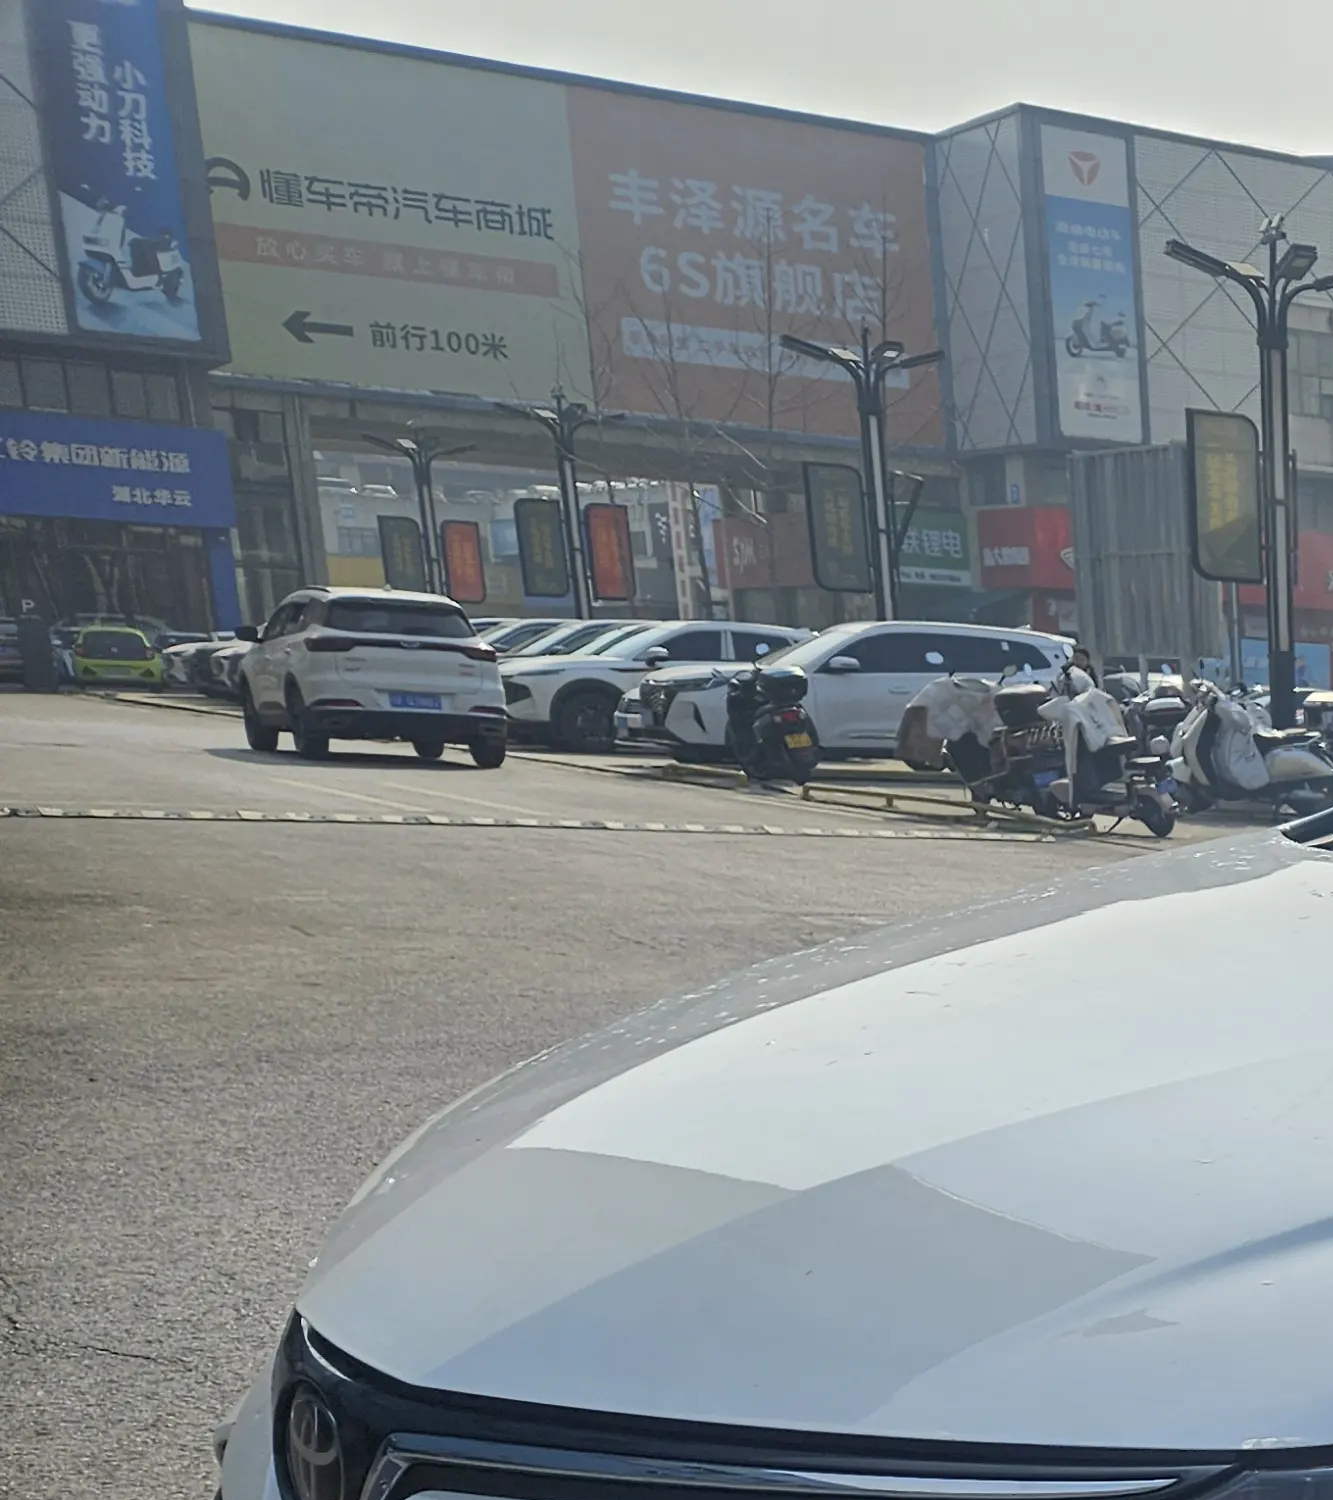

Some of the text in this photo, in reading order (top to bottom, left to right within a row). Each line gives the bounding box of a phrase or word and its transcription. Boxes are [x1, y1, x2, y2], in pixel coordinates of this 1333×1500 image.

[67, 20, 111, 143] 更强动力
[113, 60, 157, 180] 小刀科技
[258, 168, 555, 241] 懂车帝汽车商城
[607, 166, 900, 259] 丰泽源名车
[255, 235, 365, 268] 放心买车
[640, 245, 884, 328] 6S旗舰店
[369, 320, 509, 360] 前行100米
[0, 436, 191, 474] 铃集团新能源
